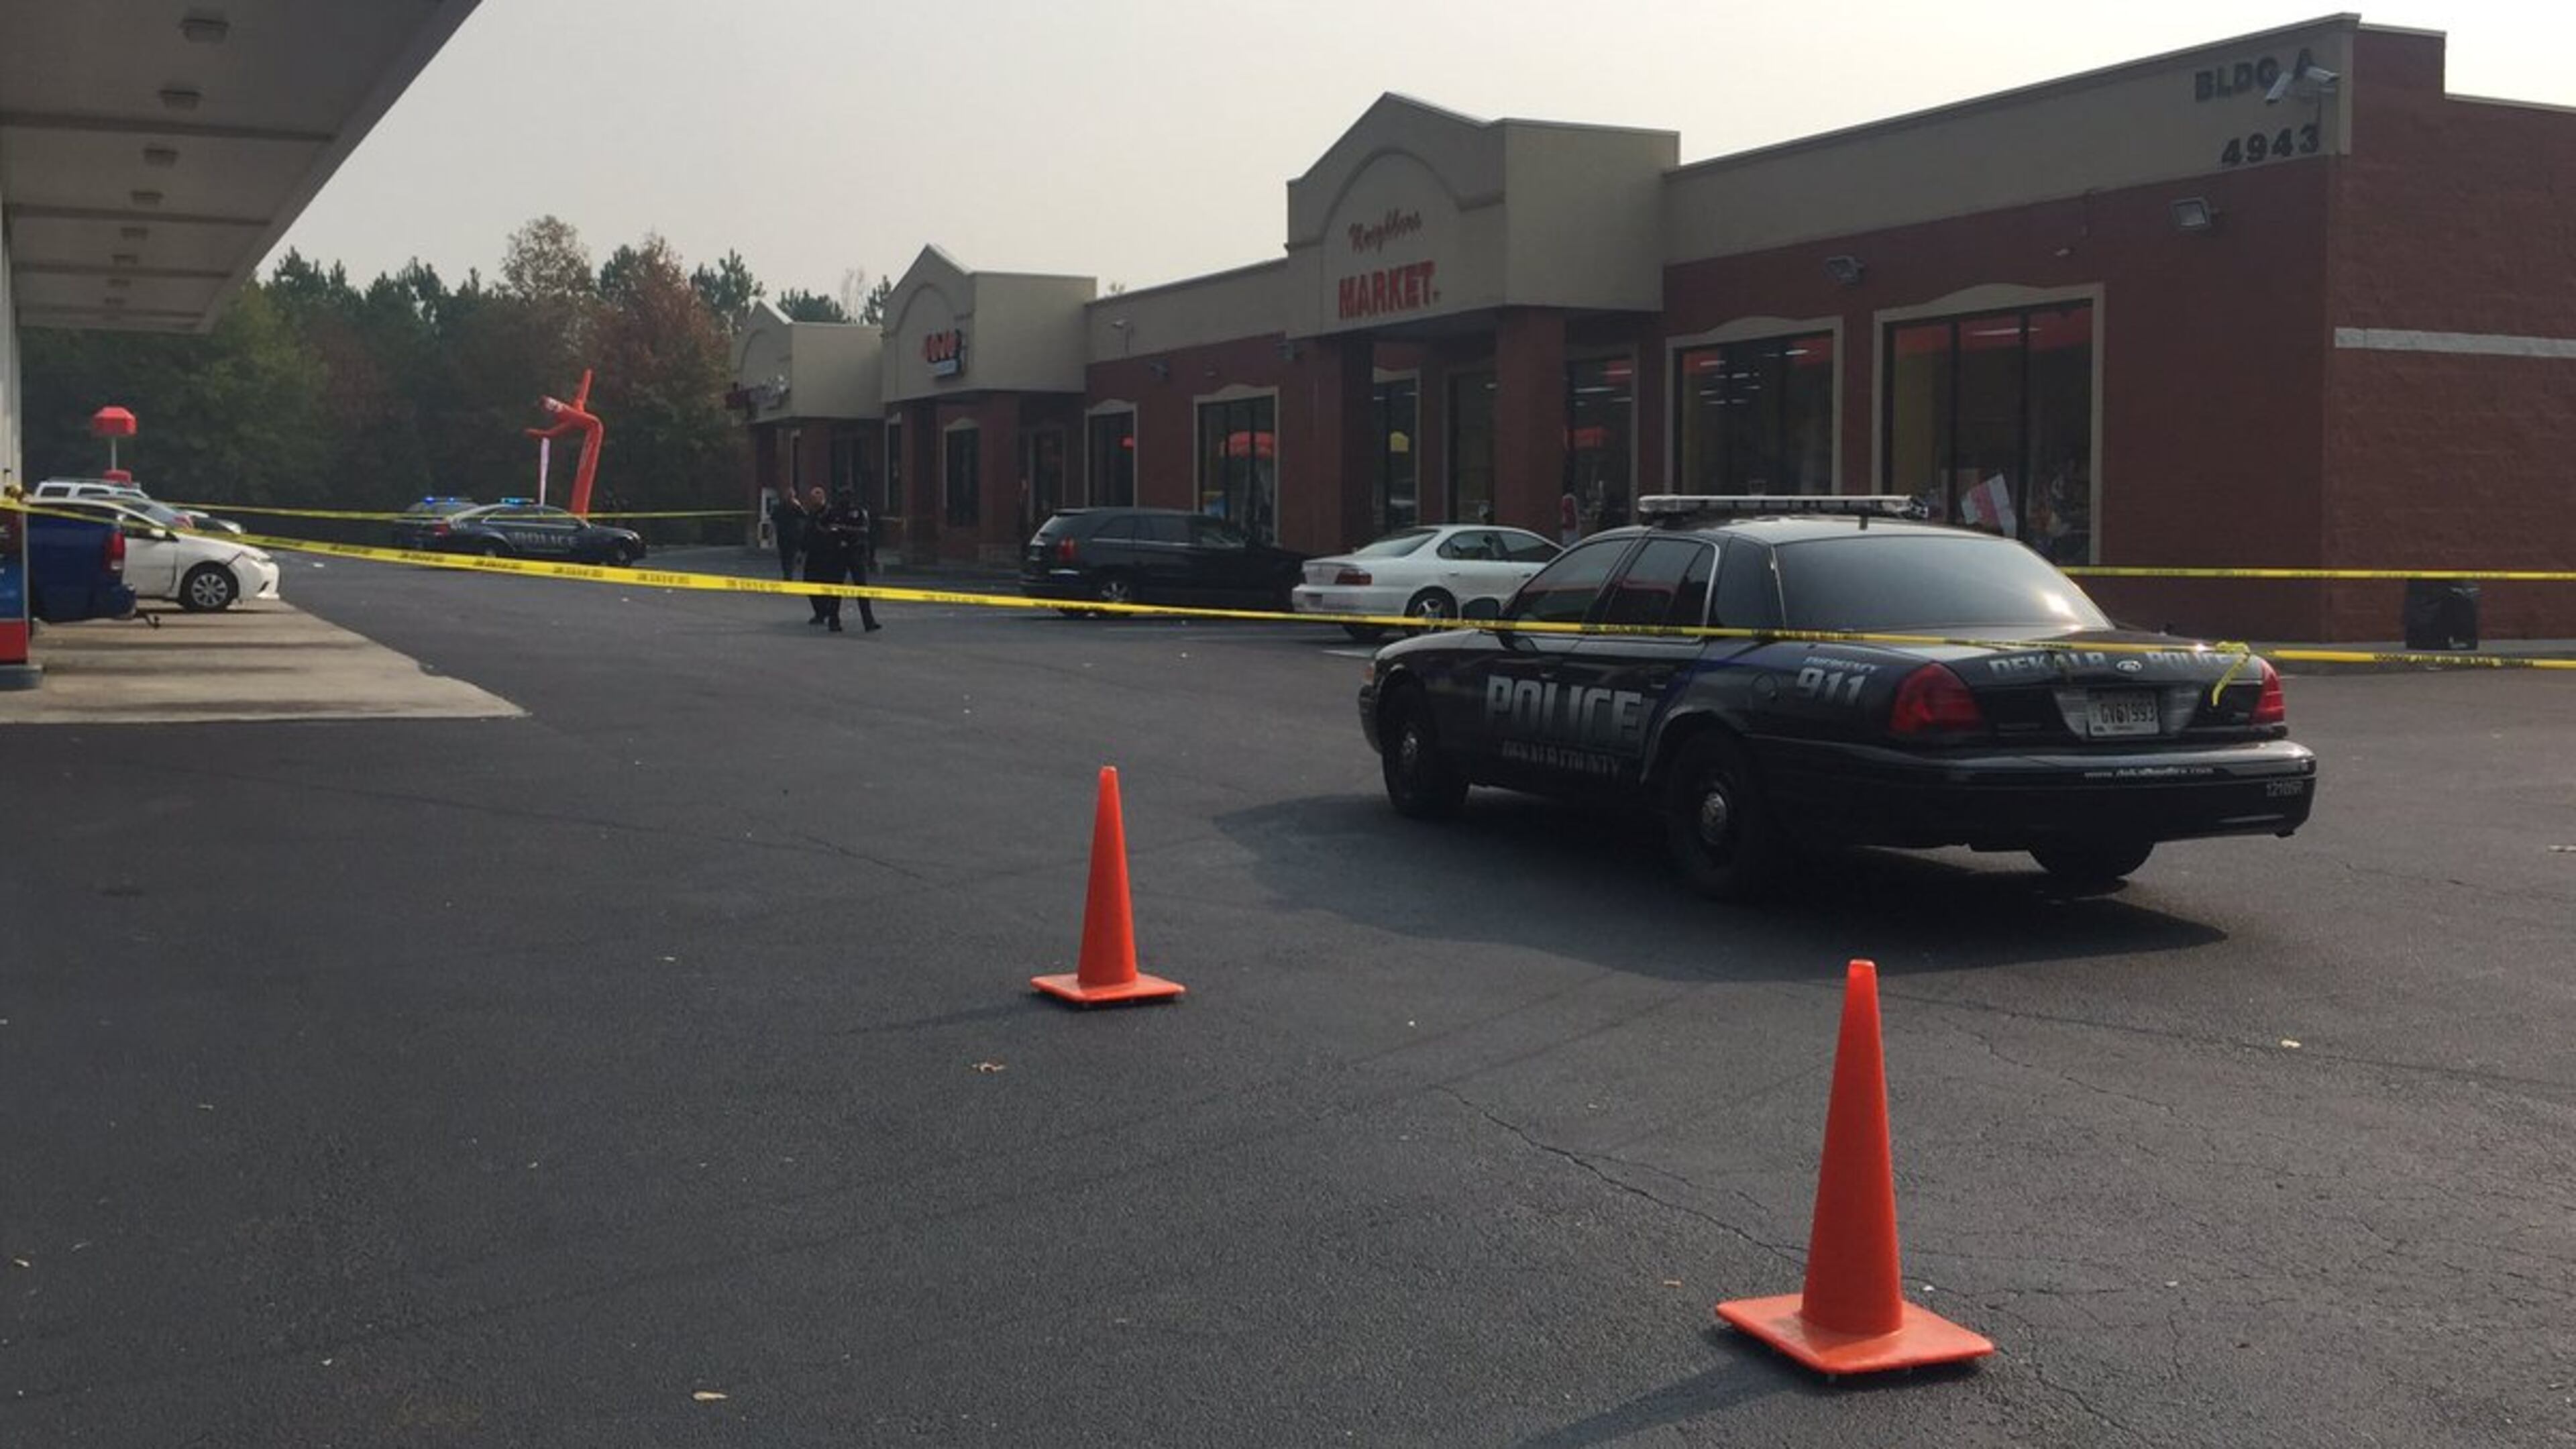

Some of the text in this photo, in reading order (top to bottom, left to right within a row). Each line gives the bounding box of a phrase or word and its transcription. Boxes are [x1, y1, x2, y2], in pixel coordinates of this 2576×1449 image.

[2220, 123, 2319, 163] 4943
[1485, 675, 1642, 738] POLICE
[1797, 667, 1866, 706] 911
